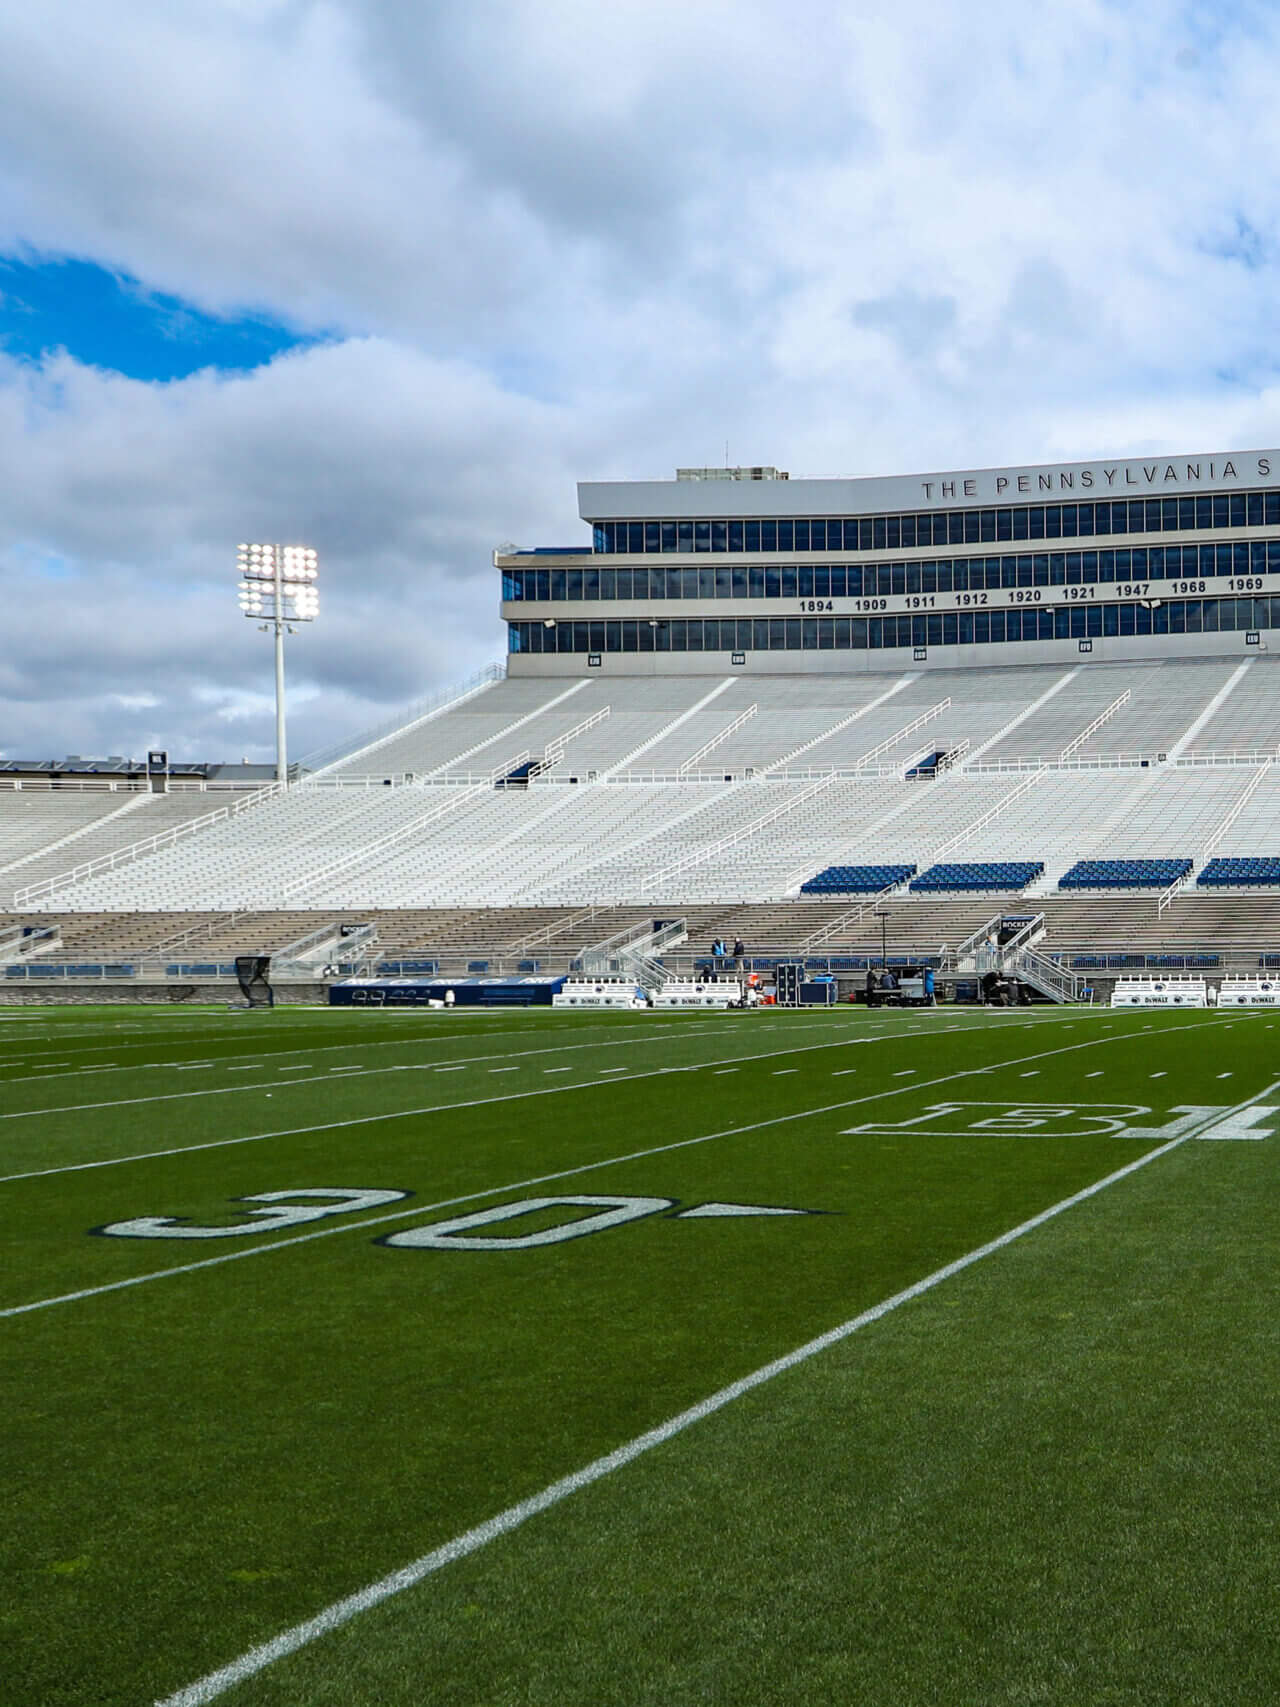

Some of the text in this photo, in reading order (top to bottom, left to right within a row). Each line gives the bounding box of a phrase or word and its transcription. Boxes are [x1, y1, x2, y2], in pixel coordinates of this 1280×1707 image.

[920, 478, 977, 500] THE
[996, 460, 1238, 495] PENNSYLVANIA
[799, 600, 833, 612] 1894
[854, 599, 888, 611] 1909
[904, 596, 936, 608] 1911
[954, 593, 989, 606] 1912
[1007, 590, 1042, 602] 1920
[1061, 587, 1096, 600] 1921
[1115, 584, 1151, 597] 1947
[1170, 581, 1207, 594] 1968
[1227, 578, 1263, 591] 1969
